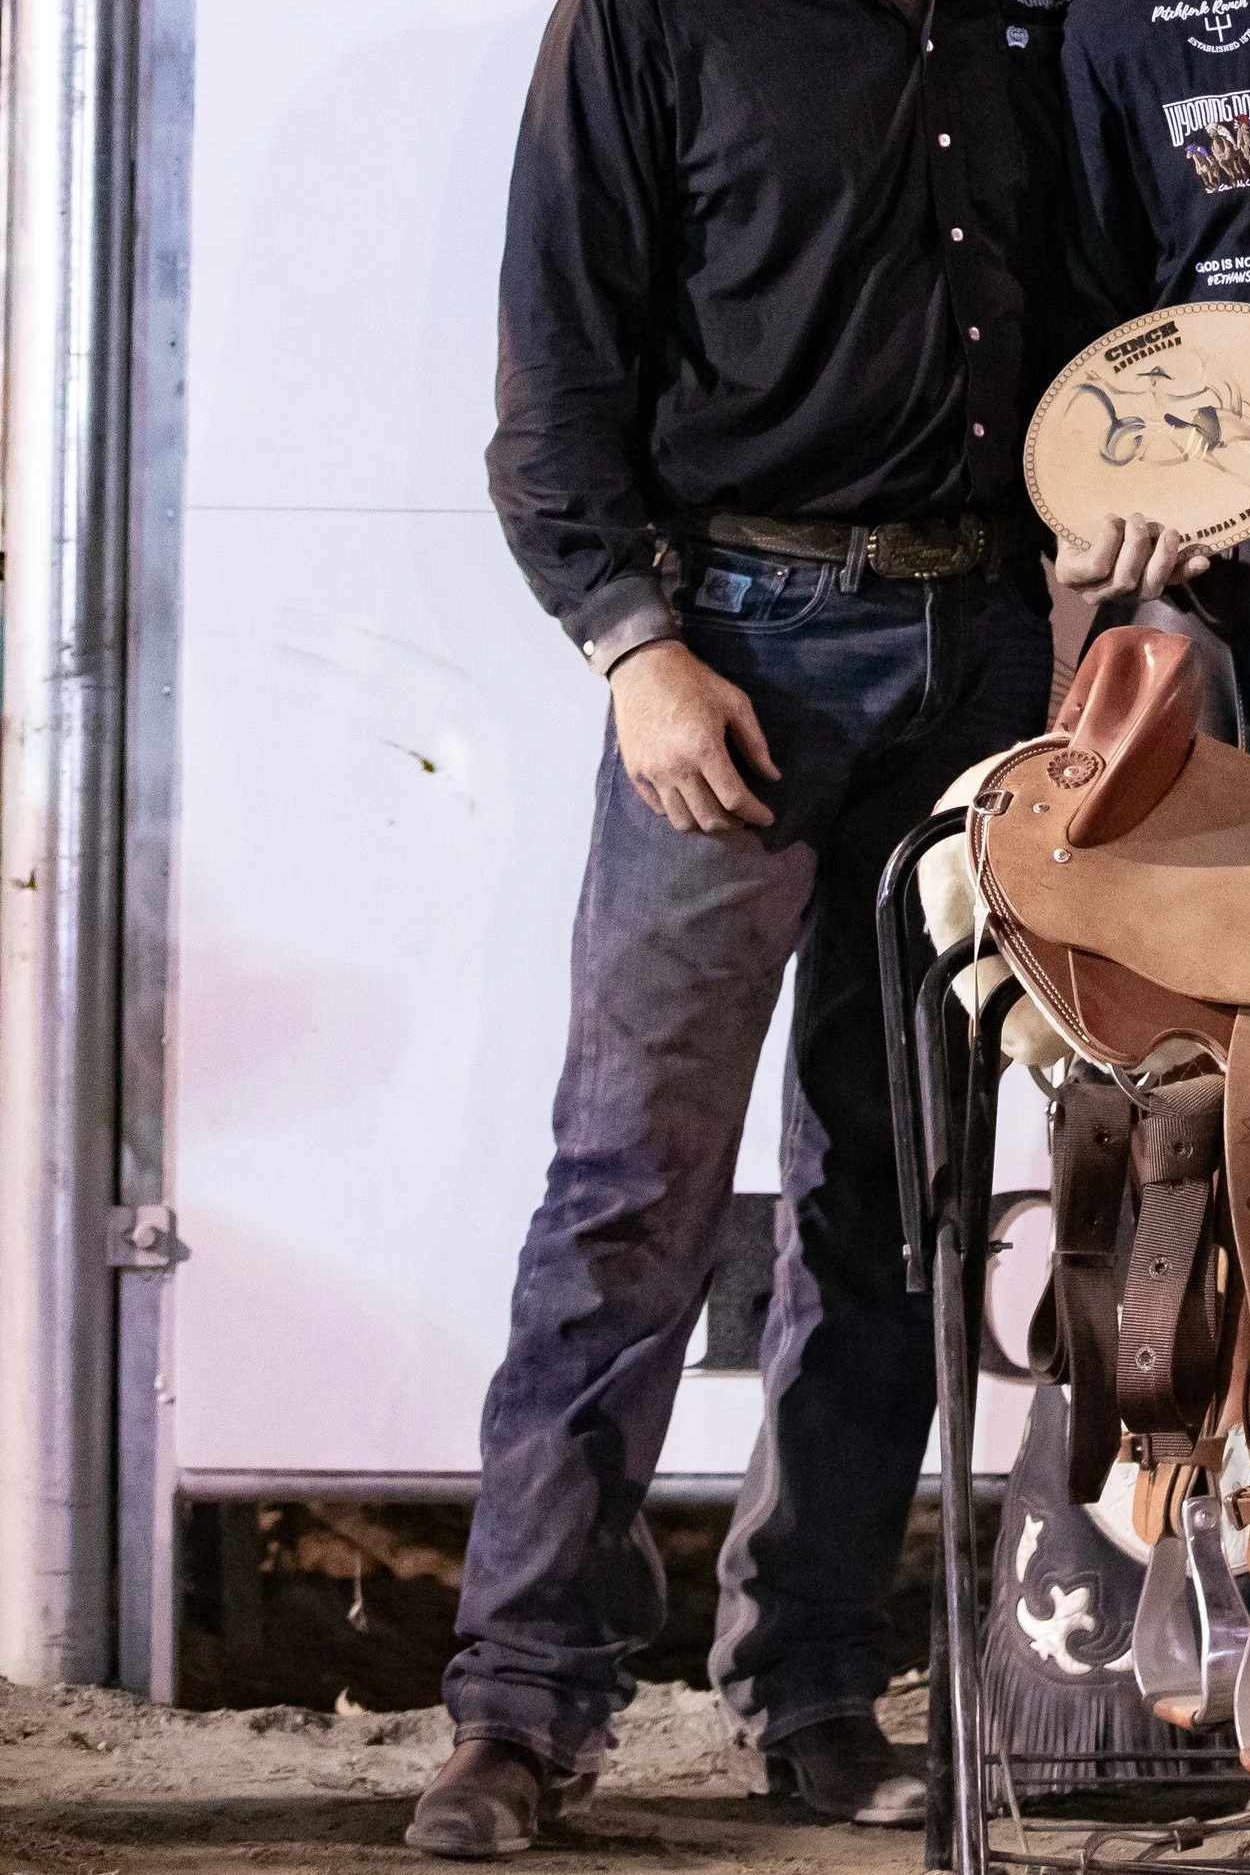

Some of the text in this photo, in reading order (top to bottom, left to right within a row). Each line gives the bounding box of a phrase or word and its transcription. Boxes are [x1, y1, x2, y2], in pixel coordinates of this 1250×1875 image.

[1152, 1, 1210, 22] Pitchfork
[1187, 36, 1240, 53] ESTABLISHED
[1195, 260, 1220, 273] GOD
[1221, 258, 1233, 271] IS
[1104, 320, 1179, 363] CINCH
[1113, 337, 1182, 374] AUSTRALIAN
